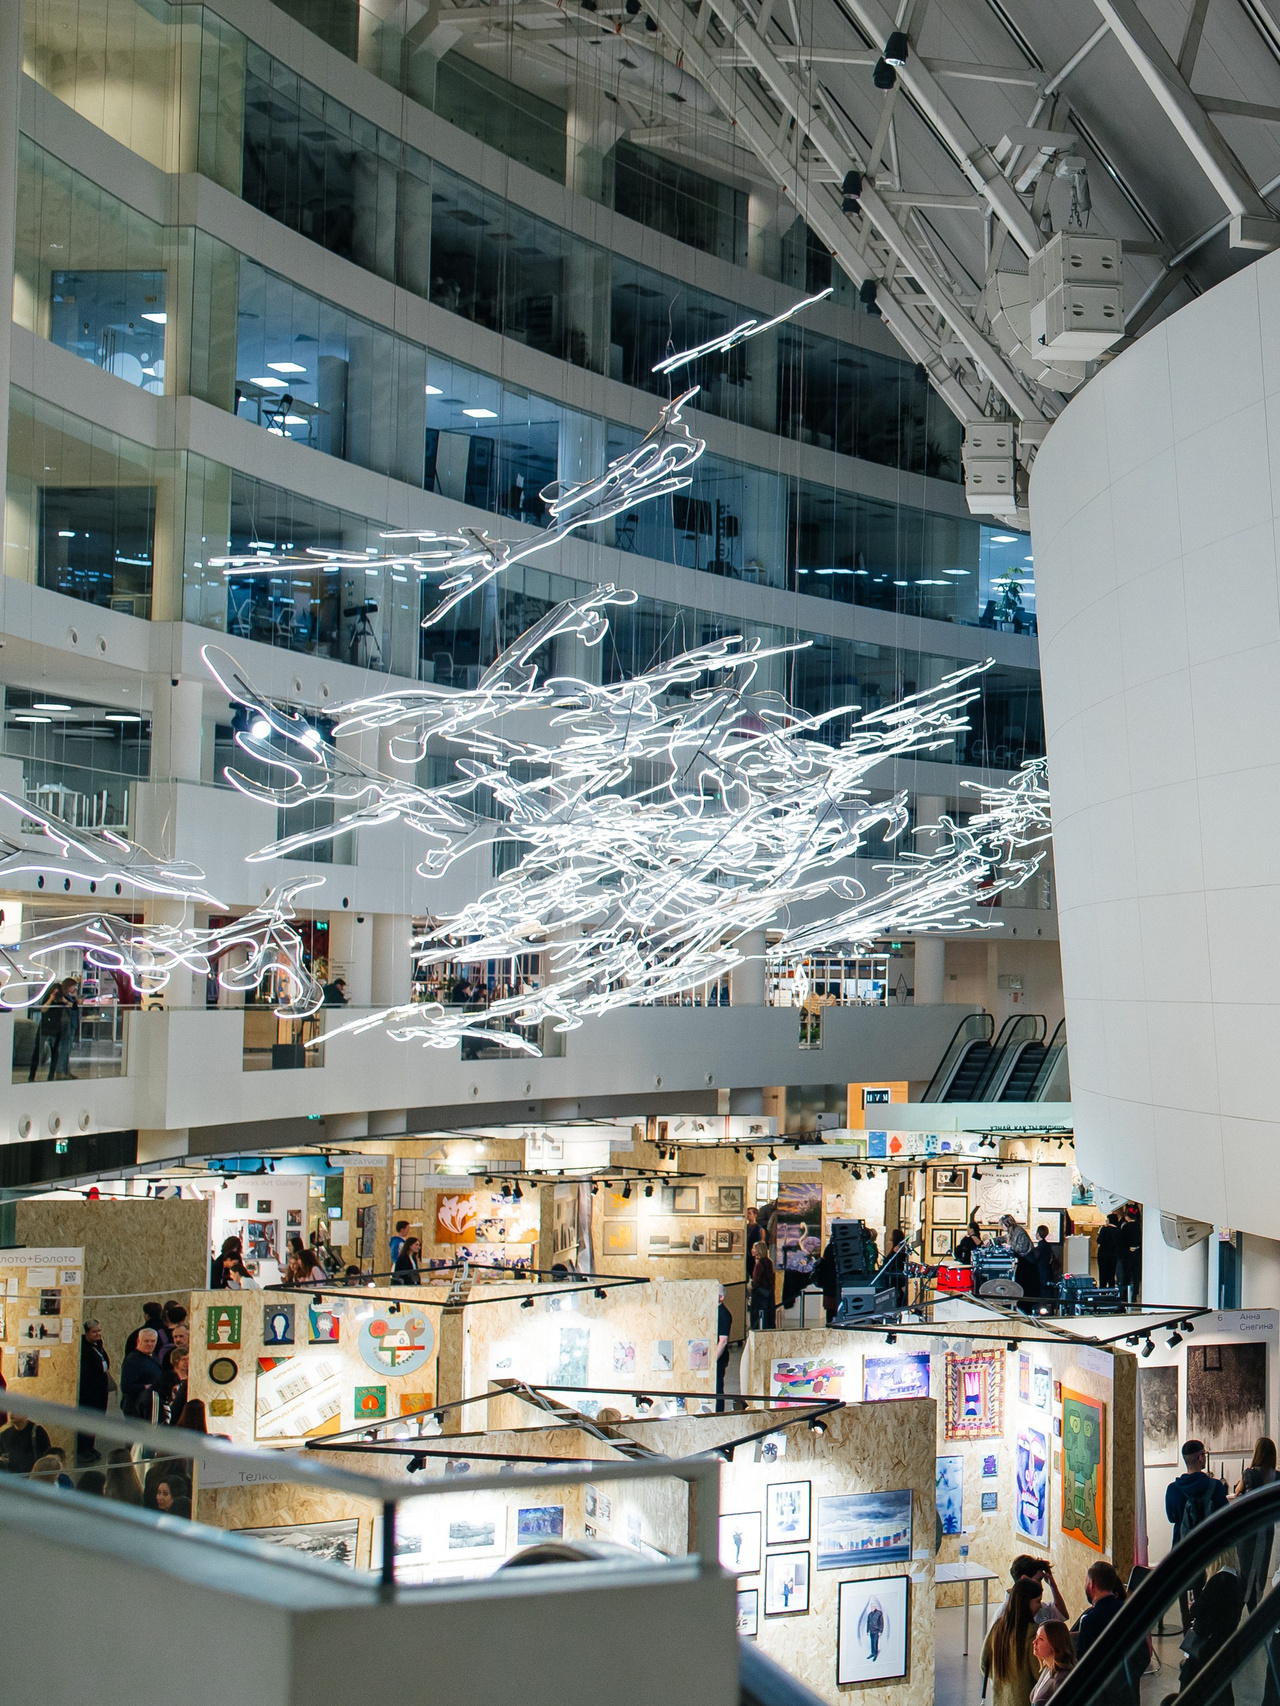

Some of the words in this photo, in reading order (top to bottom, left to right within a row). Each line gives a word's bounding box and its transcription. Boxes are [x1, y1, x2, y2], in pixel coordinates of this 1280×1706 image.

[1217, 1314, 1223, 1322] 6
[1239, 1313, 1261, 1321] Анна
[1239, 1322, 1274, 1332] Снегина
